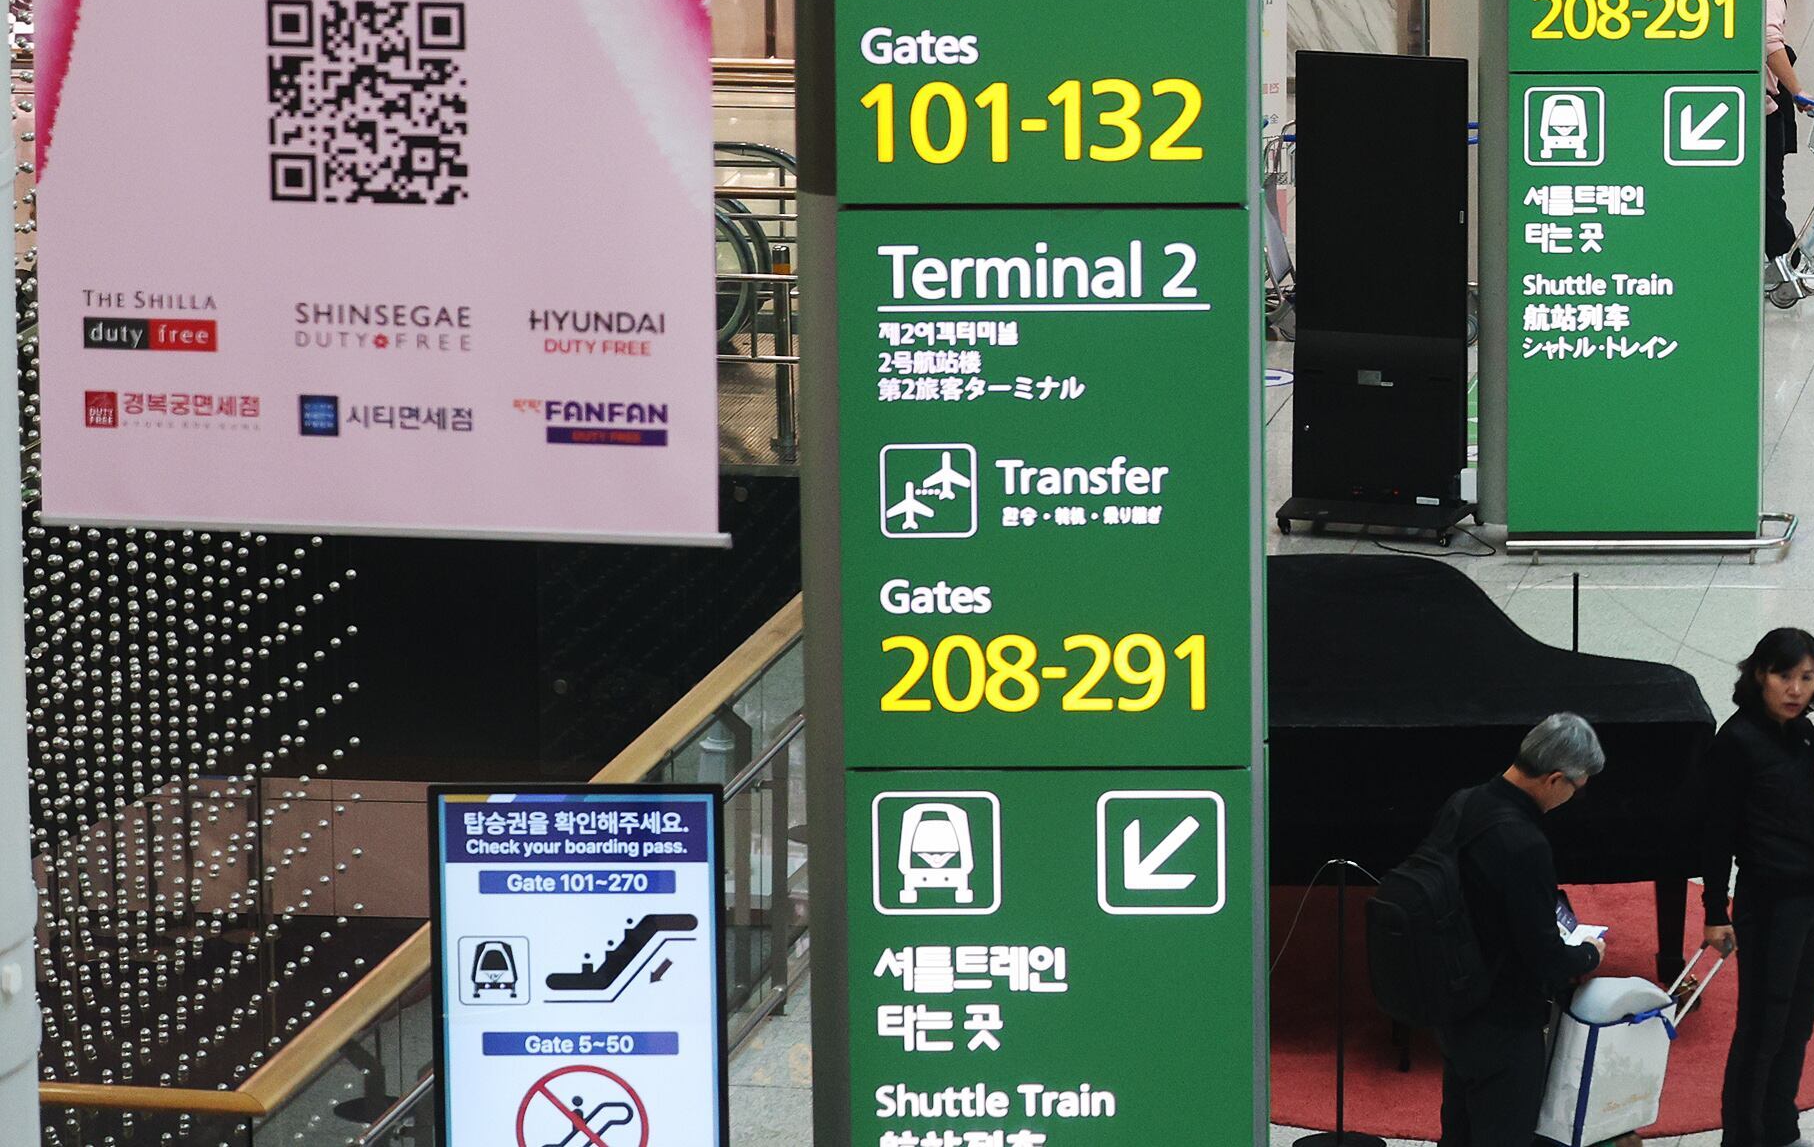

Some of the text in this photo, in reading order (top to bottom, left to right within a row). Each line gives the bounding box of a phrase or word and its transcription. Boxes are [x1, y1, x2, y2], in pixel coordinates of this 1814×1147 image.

[859, 27, 980, 65] Gates
[859, 78, 1205, 165] 101-132
[1523, 184, 1646, 216] 셔틀트레인
[1524, 222, 1605, 254] 타는 곳
[877, 239, 1198, 300] Terminal 2
[1522, 272, 1674, 296] Shuttle Train
[83, 290, 217, 310] THE SHILLA
[294, 302, 472, 328] SHINSEGAE
[529, 309, 665, 334] HYUNDAI
[1522, 302, 1631, 332] 航站列车
[90, 322, 209, 349] duty free
[294, 331, 471, 351] DUTY FREE
[877, 319, 1020, 346] 제2여객터미널
[544, 338, 652, 356] DUTY FREE
[877, 350, 982, 375] 2号航站楼
[877, 374, 1086, 402] 第2旅客ターミナル
[123, 392, 260, 418] 경복궁면세점
[346, 405, 473, 432] 시티면세점
[545, 400, 668, 423] FANFAN
[995, 455, 1169, 496] Transfer
[878, 578, 993, 615] Gates
[879, 633, 1207, 713] 208-291
[464, 811, 689, 836] 탑승권을 확인해주세요.
[466, 839, 688, 858] Check your boarding pass.
[507, 873, 648, 892] Gate 101~270
[873, 945, 1069, 994] 셔틀트레인
[876, 1004, 1003, 1053] 타는 곳
[524, 1035, 634, 1054] Gate 5~50
[874, 1082, 1117, 1118] Shuttle Train
